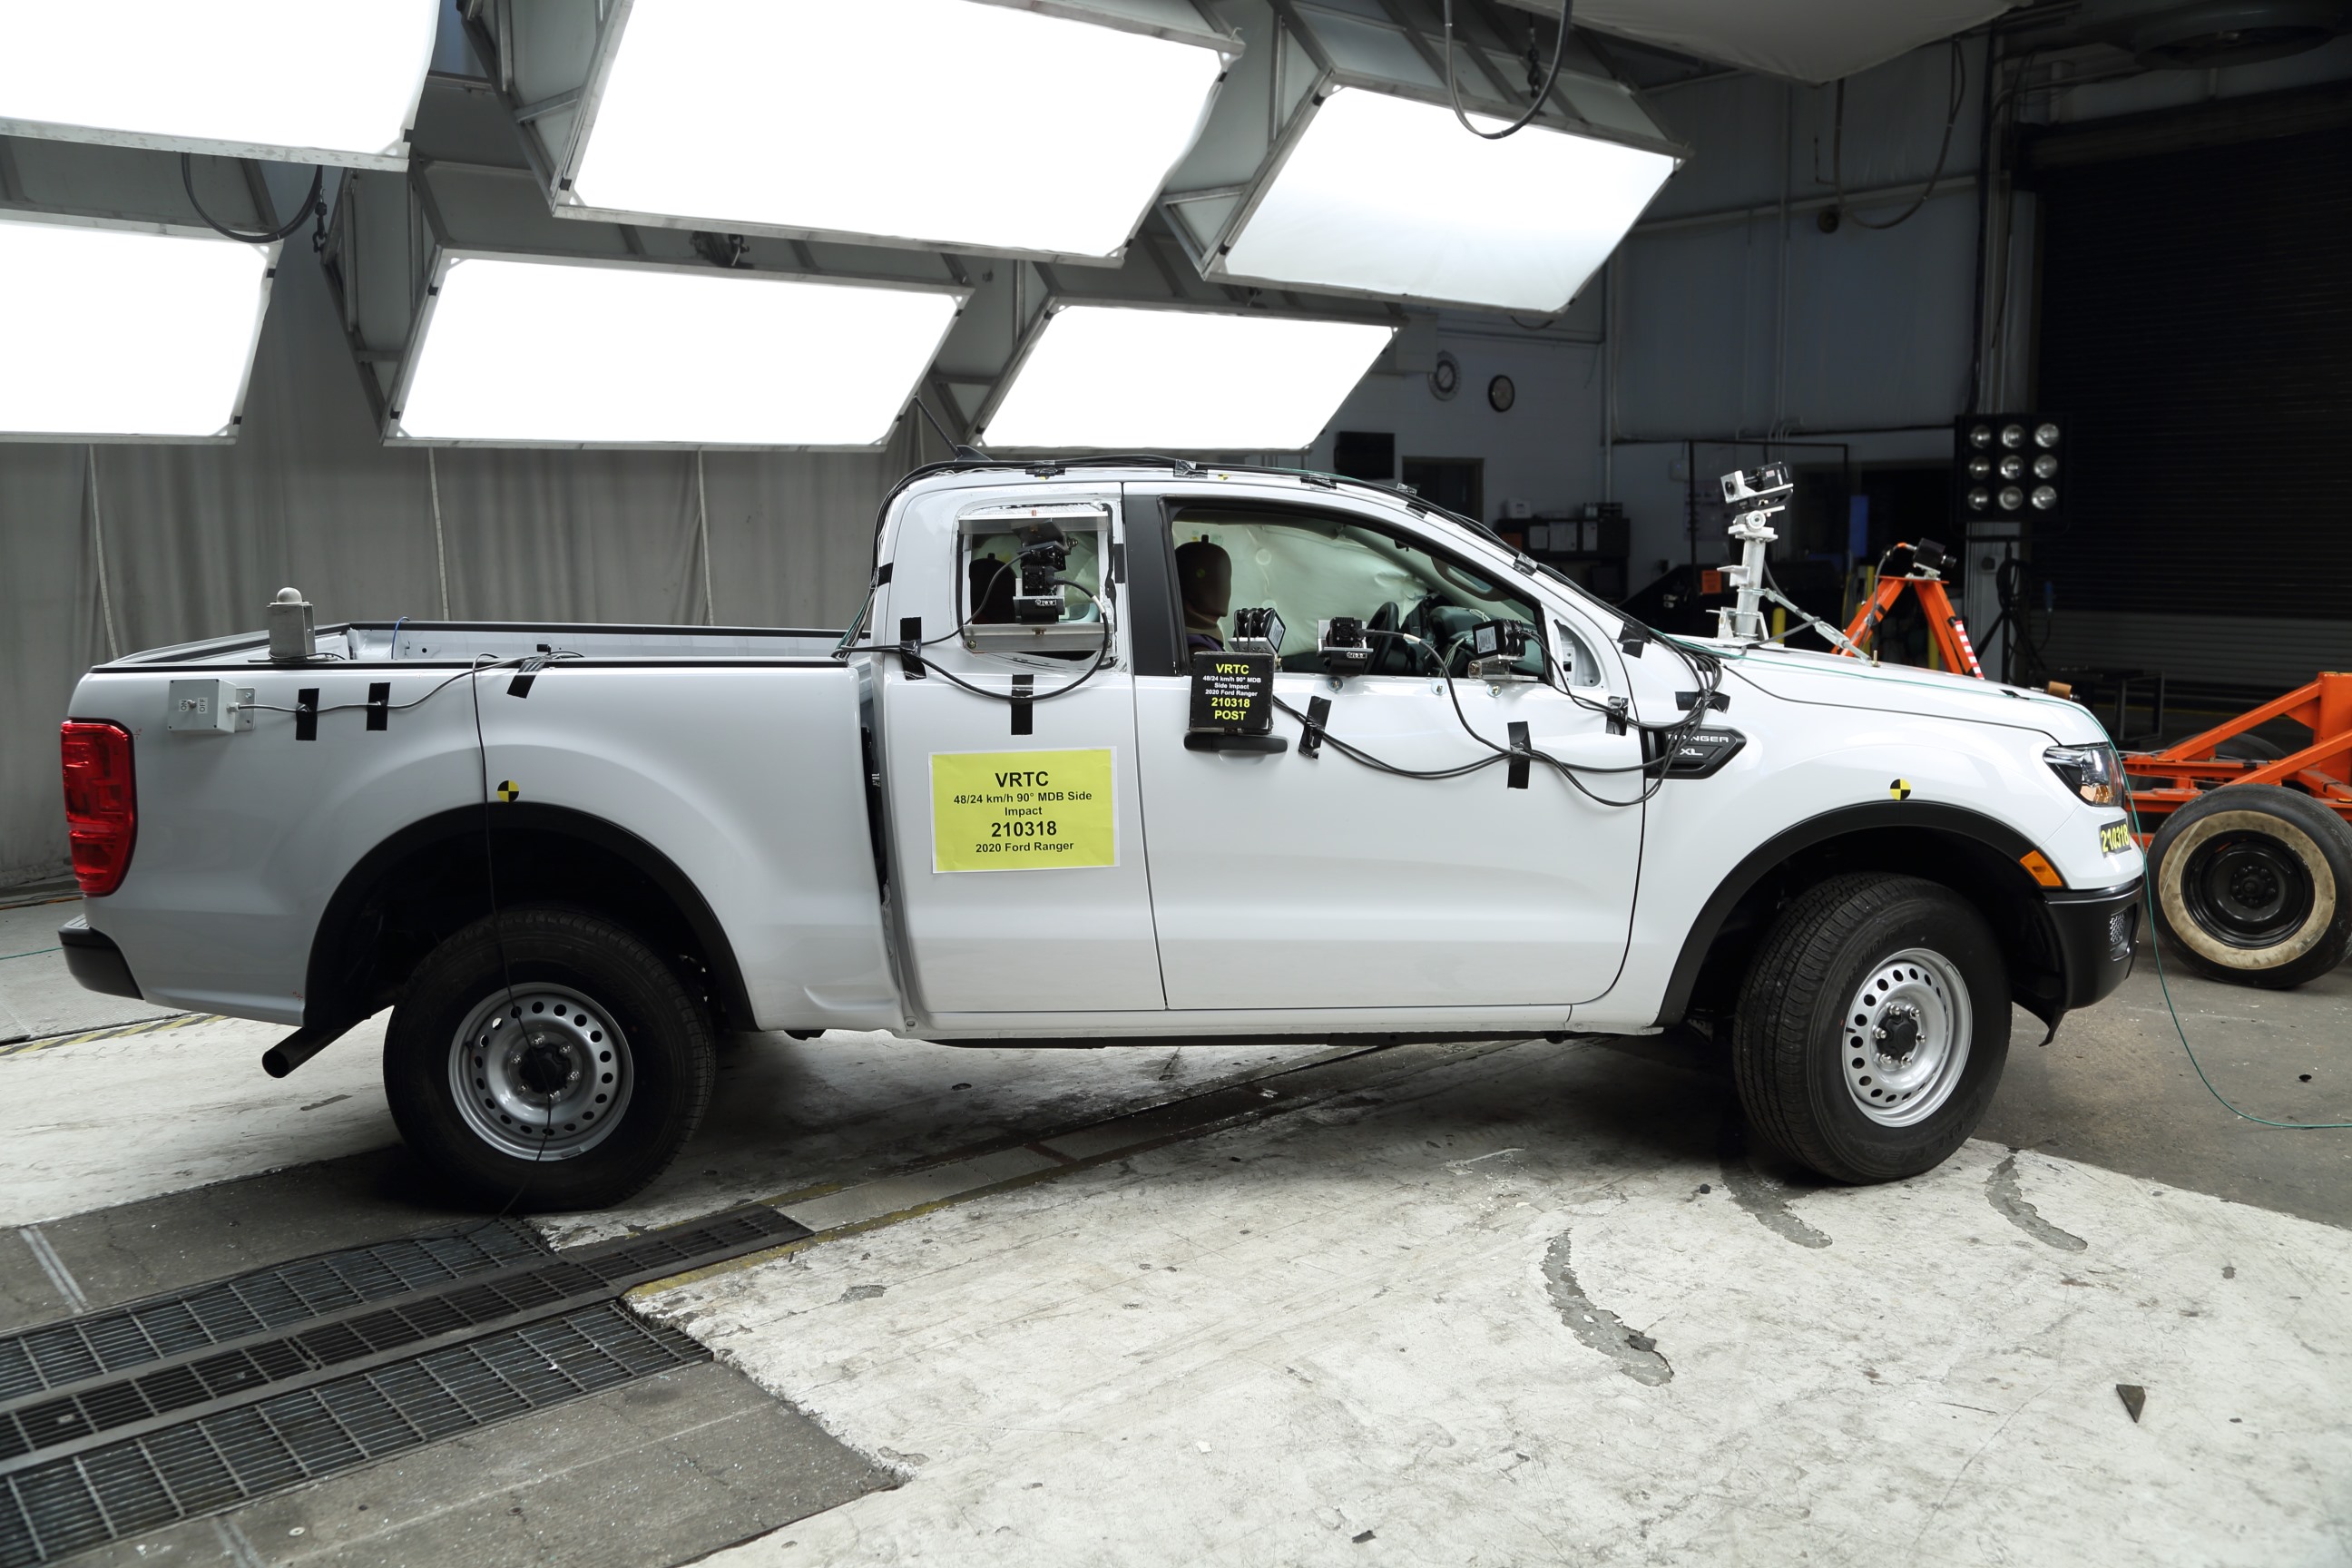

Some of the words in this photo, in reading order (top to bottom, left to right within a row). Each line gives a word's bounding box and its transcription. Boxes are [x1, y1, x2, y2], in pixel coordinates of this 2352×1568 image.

[1216, 663, 1250, 675] VRTC
[181, 700, 187, 711] ON
[1211, 697, 1250, 708] 210318
[1215, 710, 1247, 720] POST
[1680, 748, 1703, 756] XL
[995, 771, 1049, 788] VRTC
[954, 795, 984, 804] 48/24
[986, 794, 1014, 804] km/h
[1038, 792, 1064, 801] MDB
[1068, 791, 1093, 800] Side
[1004, 807, 1043, 818] Impact
[991, 821, 1057, 838] 210318
[2101, 823, 2130, 852] 210318
[976, 843, 1002, 853] 2020
[1004, 842, 1031, 852] Ford
[1034, 842, 1074, 852] Ranger
